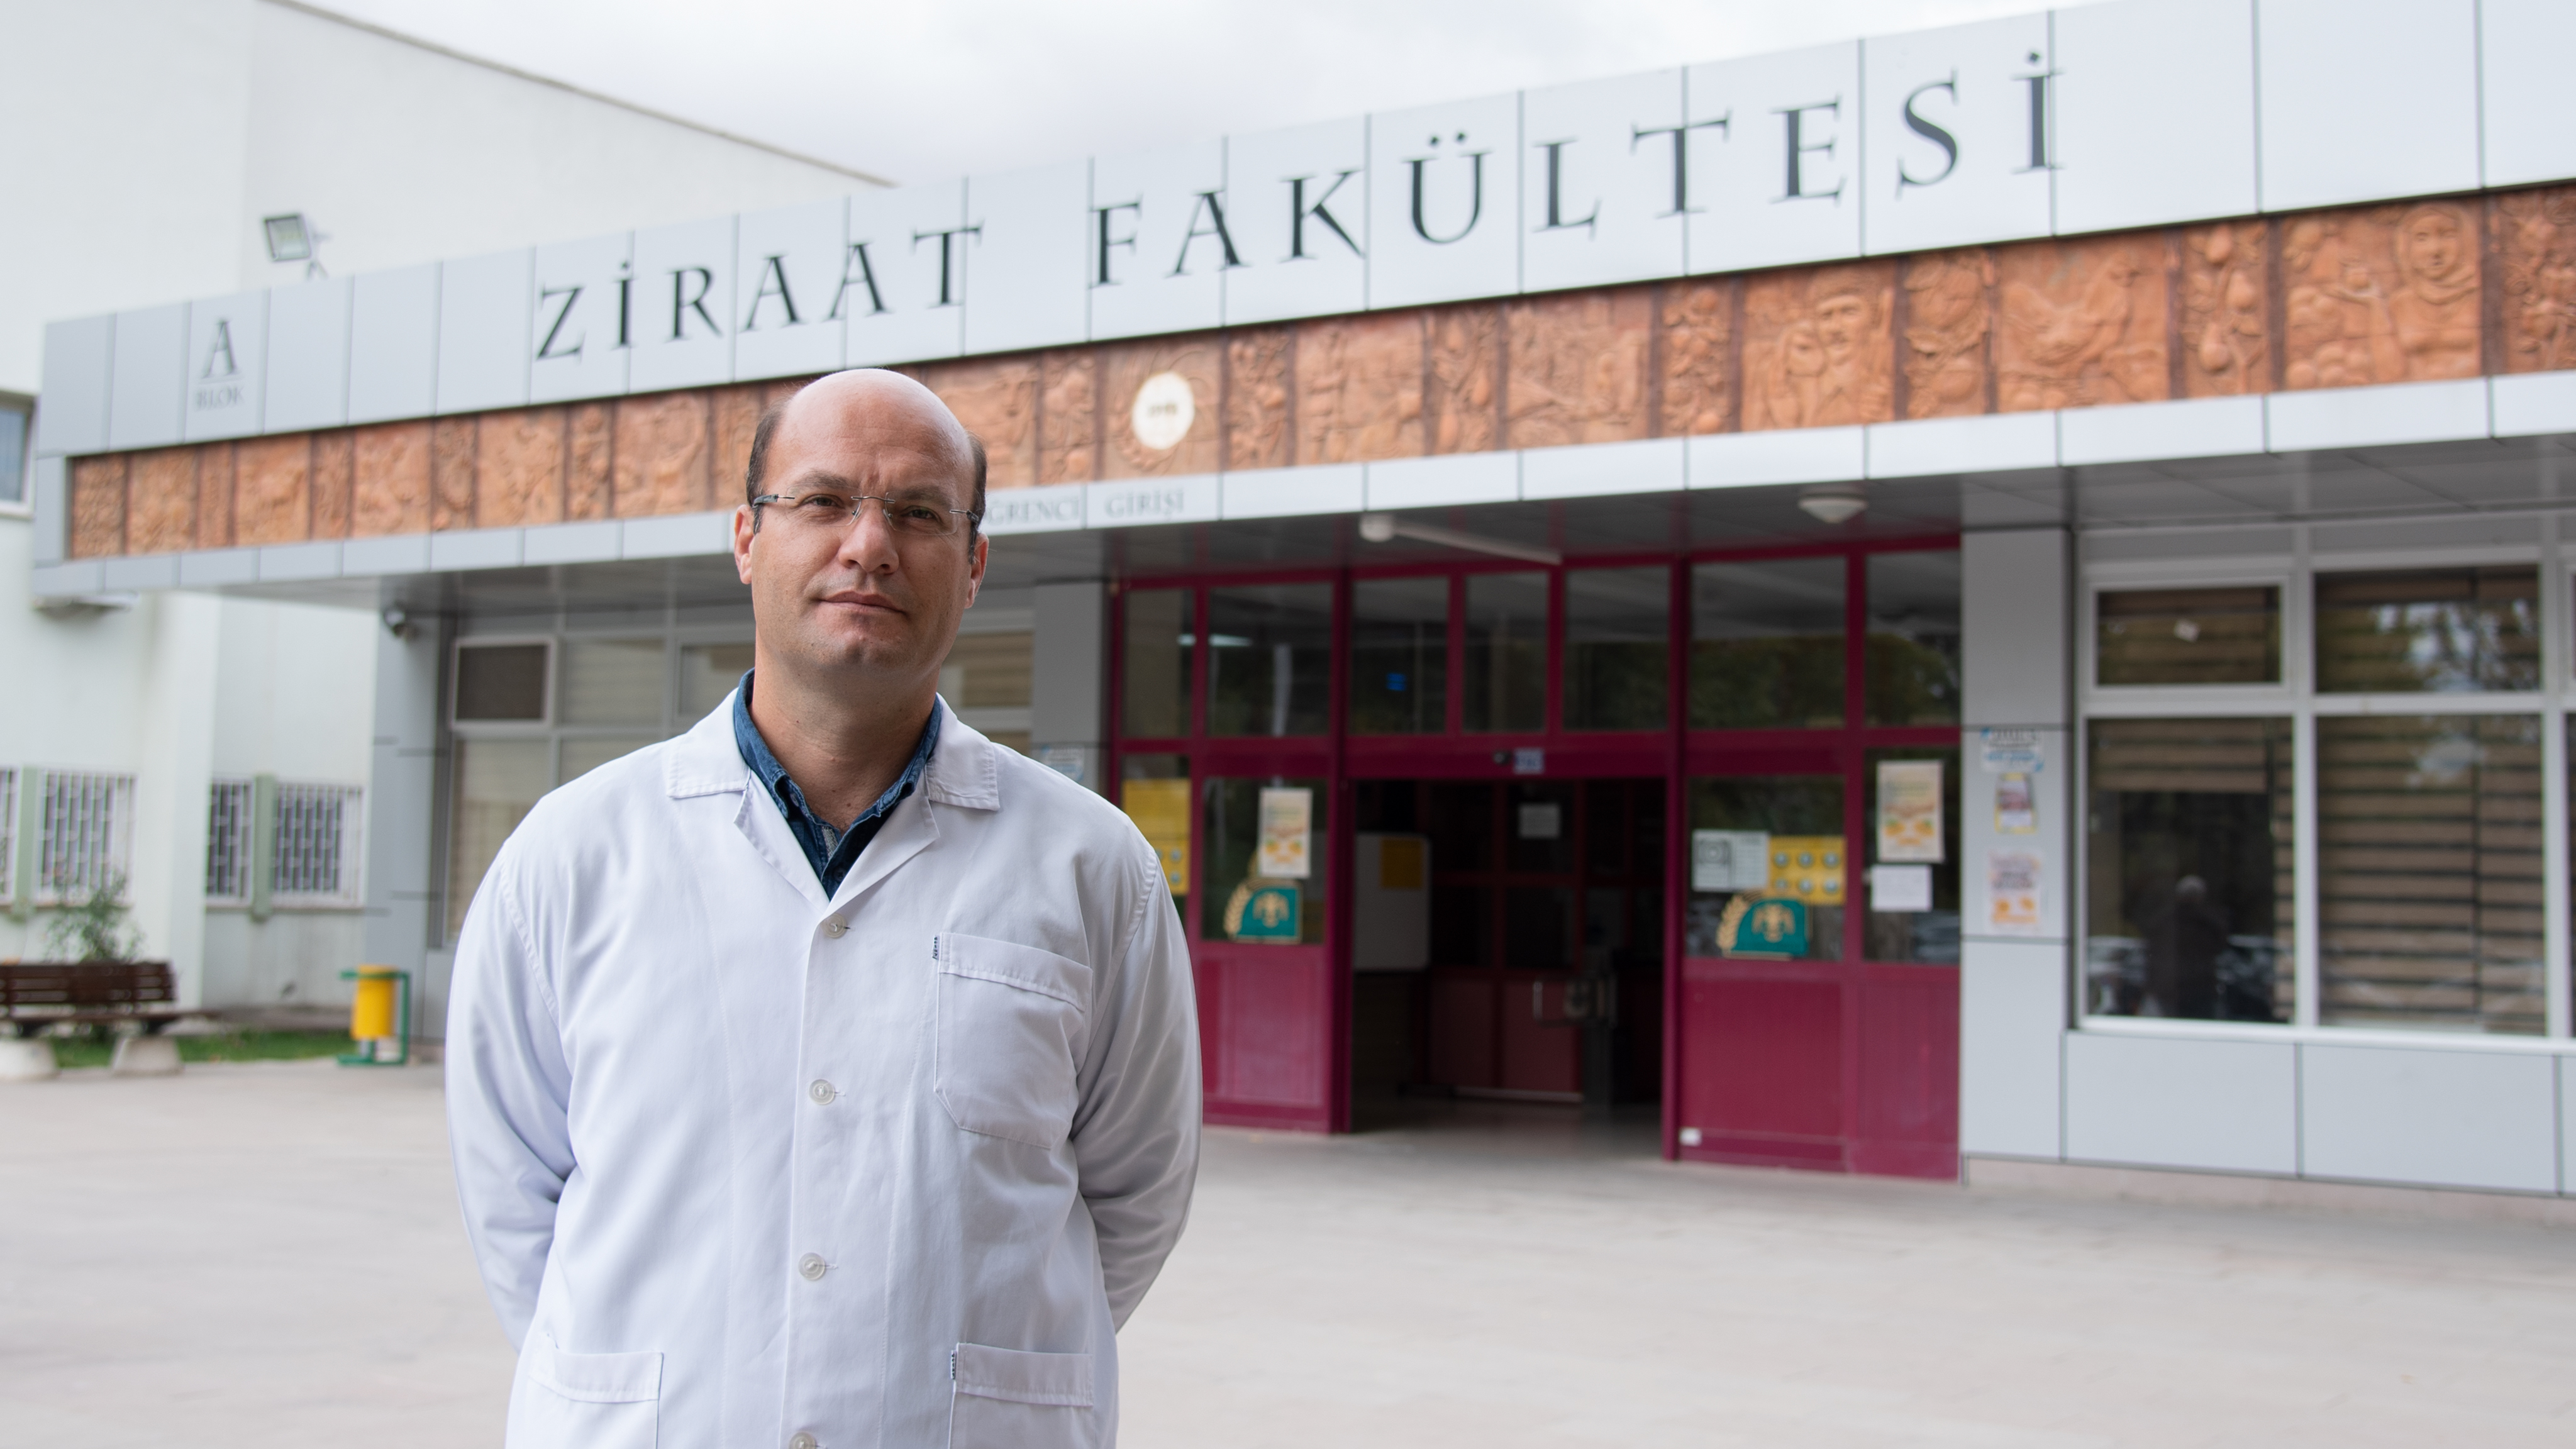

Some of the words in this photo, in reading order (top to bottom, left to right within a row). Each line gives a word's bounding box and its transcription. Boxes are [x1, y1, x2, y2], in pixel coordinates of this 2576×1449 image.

[536, 218, 984, 365] ZİRAAT
[1088, 48, 2065, 289] FAKÜLTESİ
[199, 318, 242, 380] A
[194, 385, 245, 411] BLOK
[985, 494, 1079, 526] ĞRENCİ
